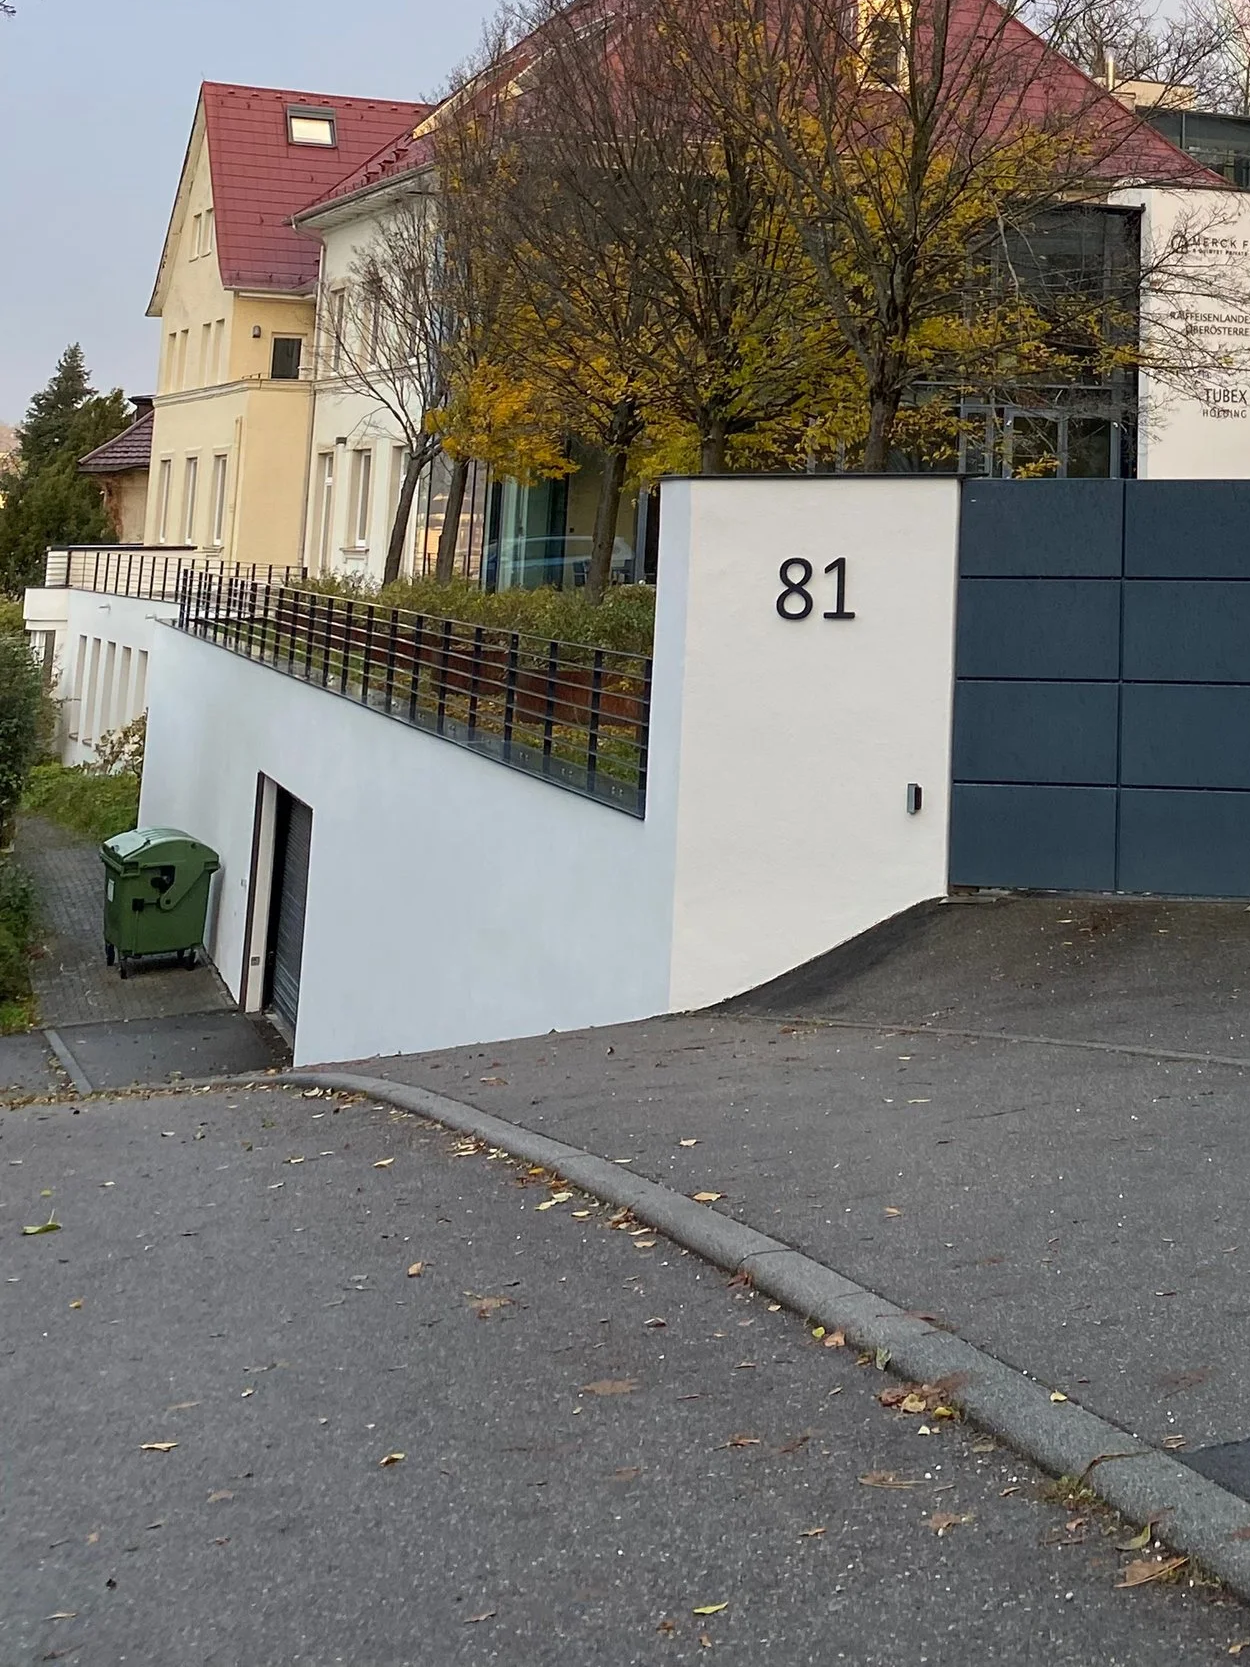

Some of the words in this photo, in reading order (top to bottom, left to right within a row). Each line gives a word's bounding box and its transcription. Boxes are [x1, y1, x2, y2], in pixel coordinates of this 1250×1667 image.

[1204, 388, 1247, 404] TUBEX
[1203, 408, 1247, 418] HOLDING
[776, 557, 855, 620] 81
